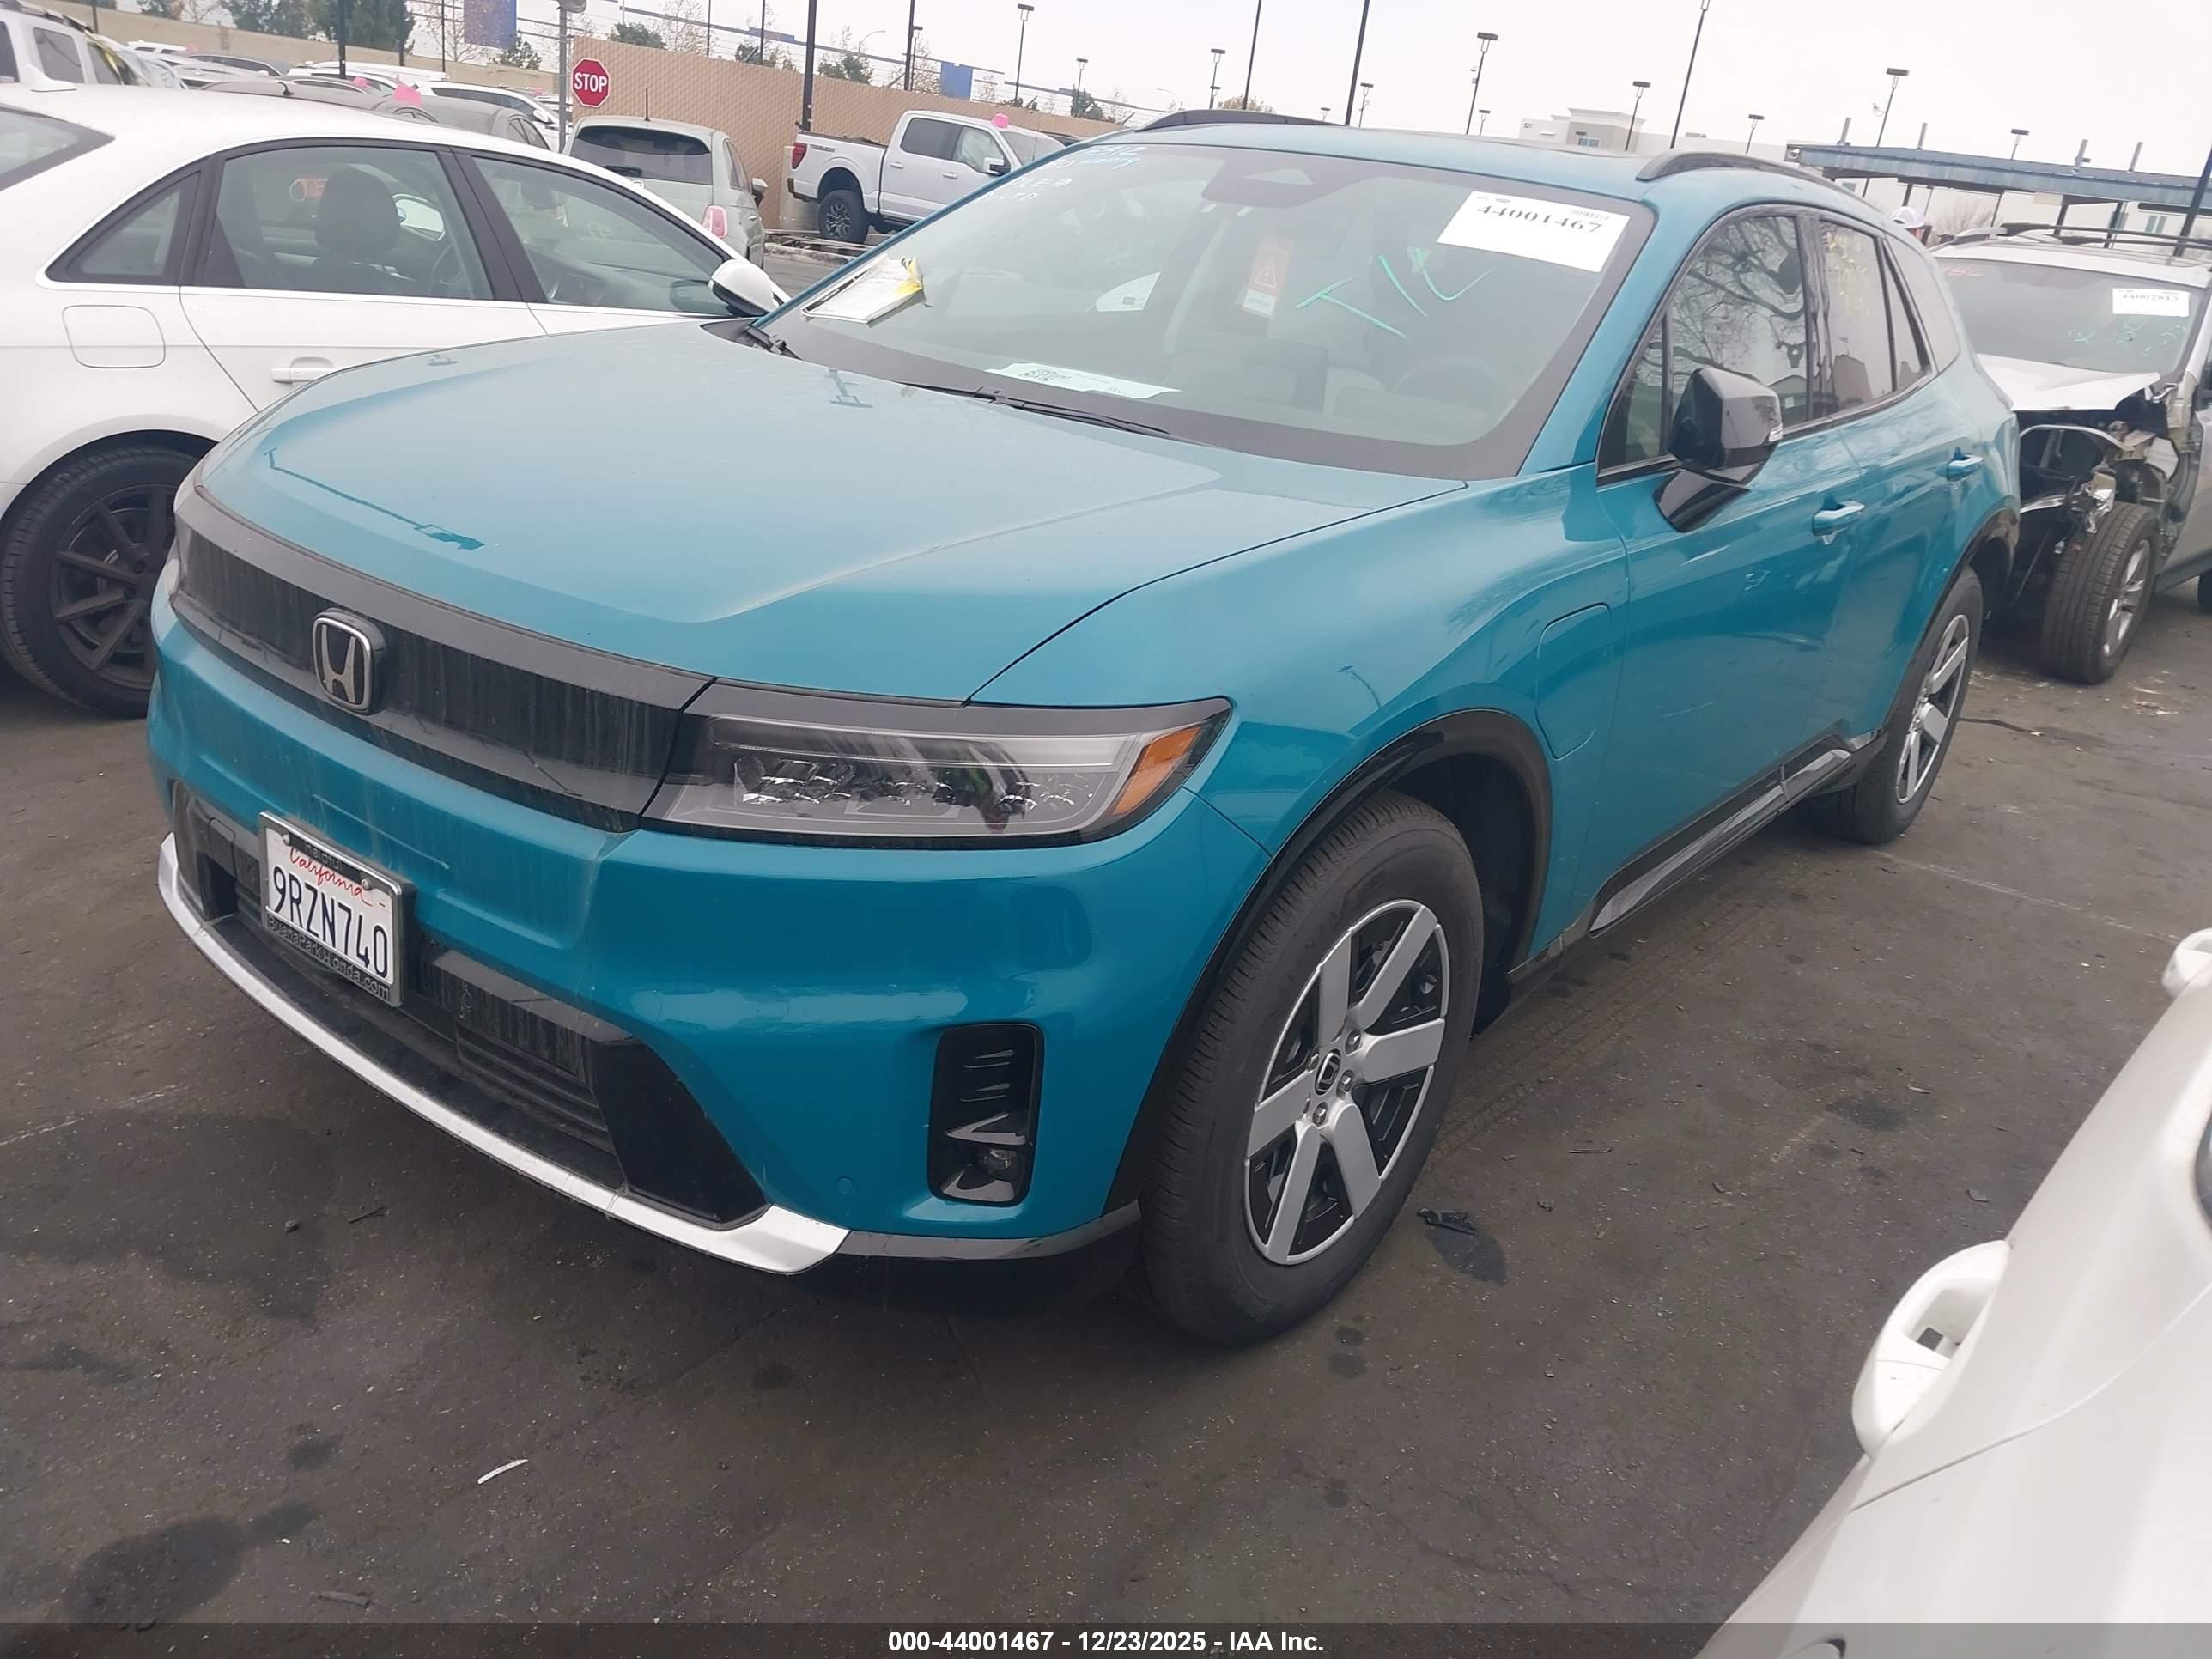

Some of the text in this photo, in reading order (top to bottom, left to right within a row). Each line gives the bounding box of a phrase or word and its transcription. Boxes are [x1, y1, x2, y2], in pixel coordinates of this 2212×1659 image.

[574, 72, 607, 93] STOP
[1476, 204, 1603, 233] 44001467
[289, 847, 373, 908] California
[273, 865, 388, 979] 9RZN740
